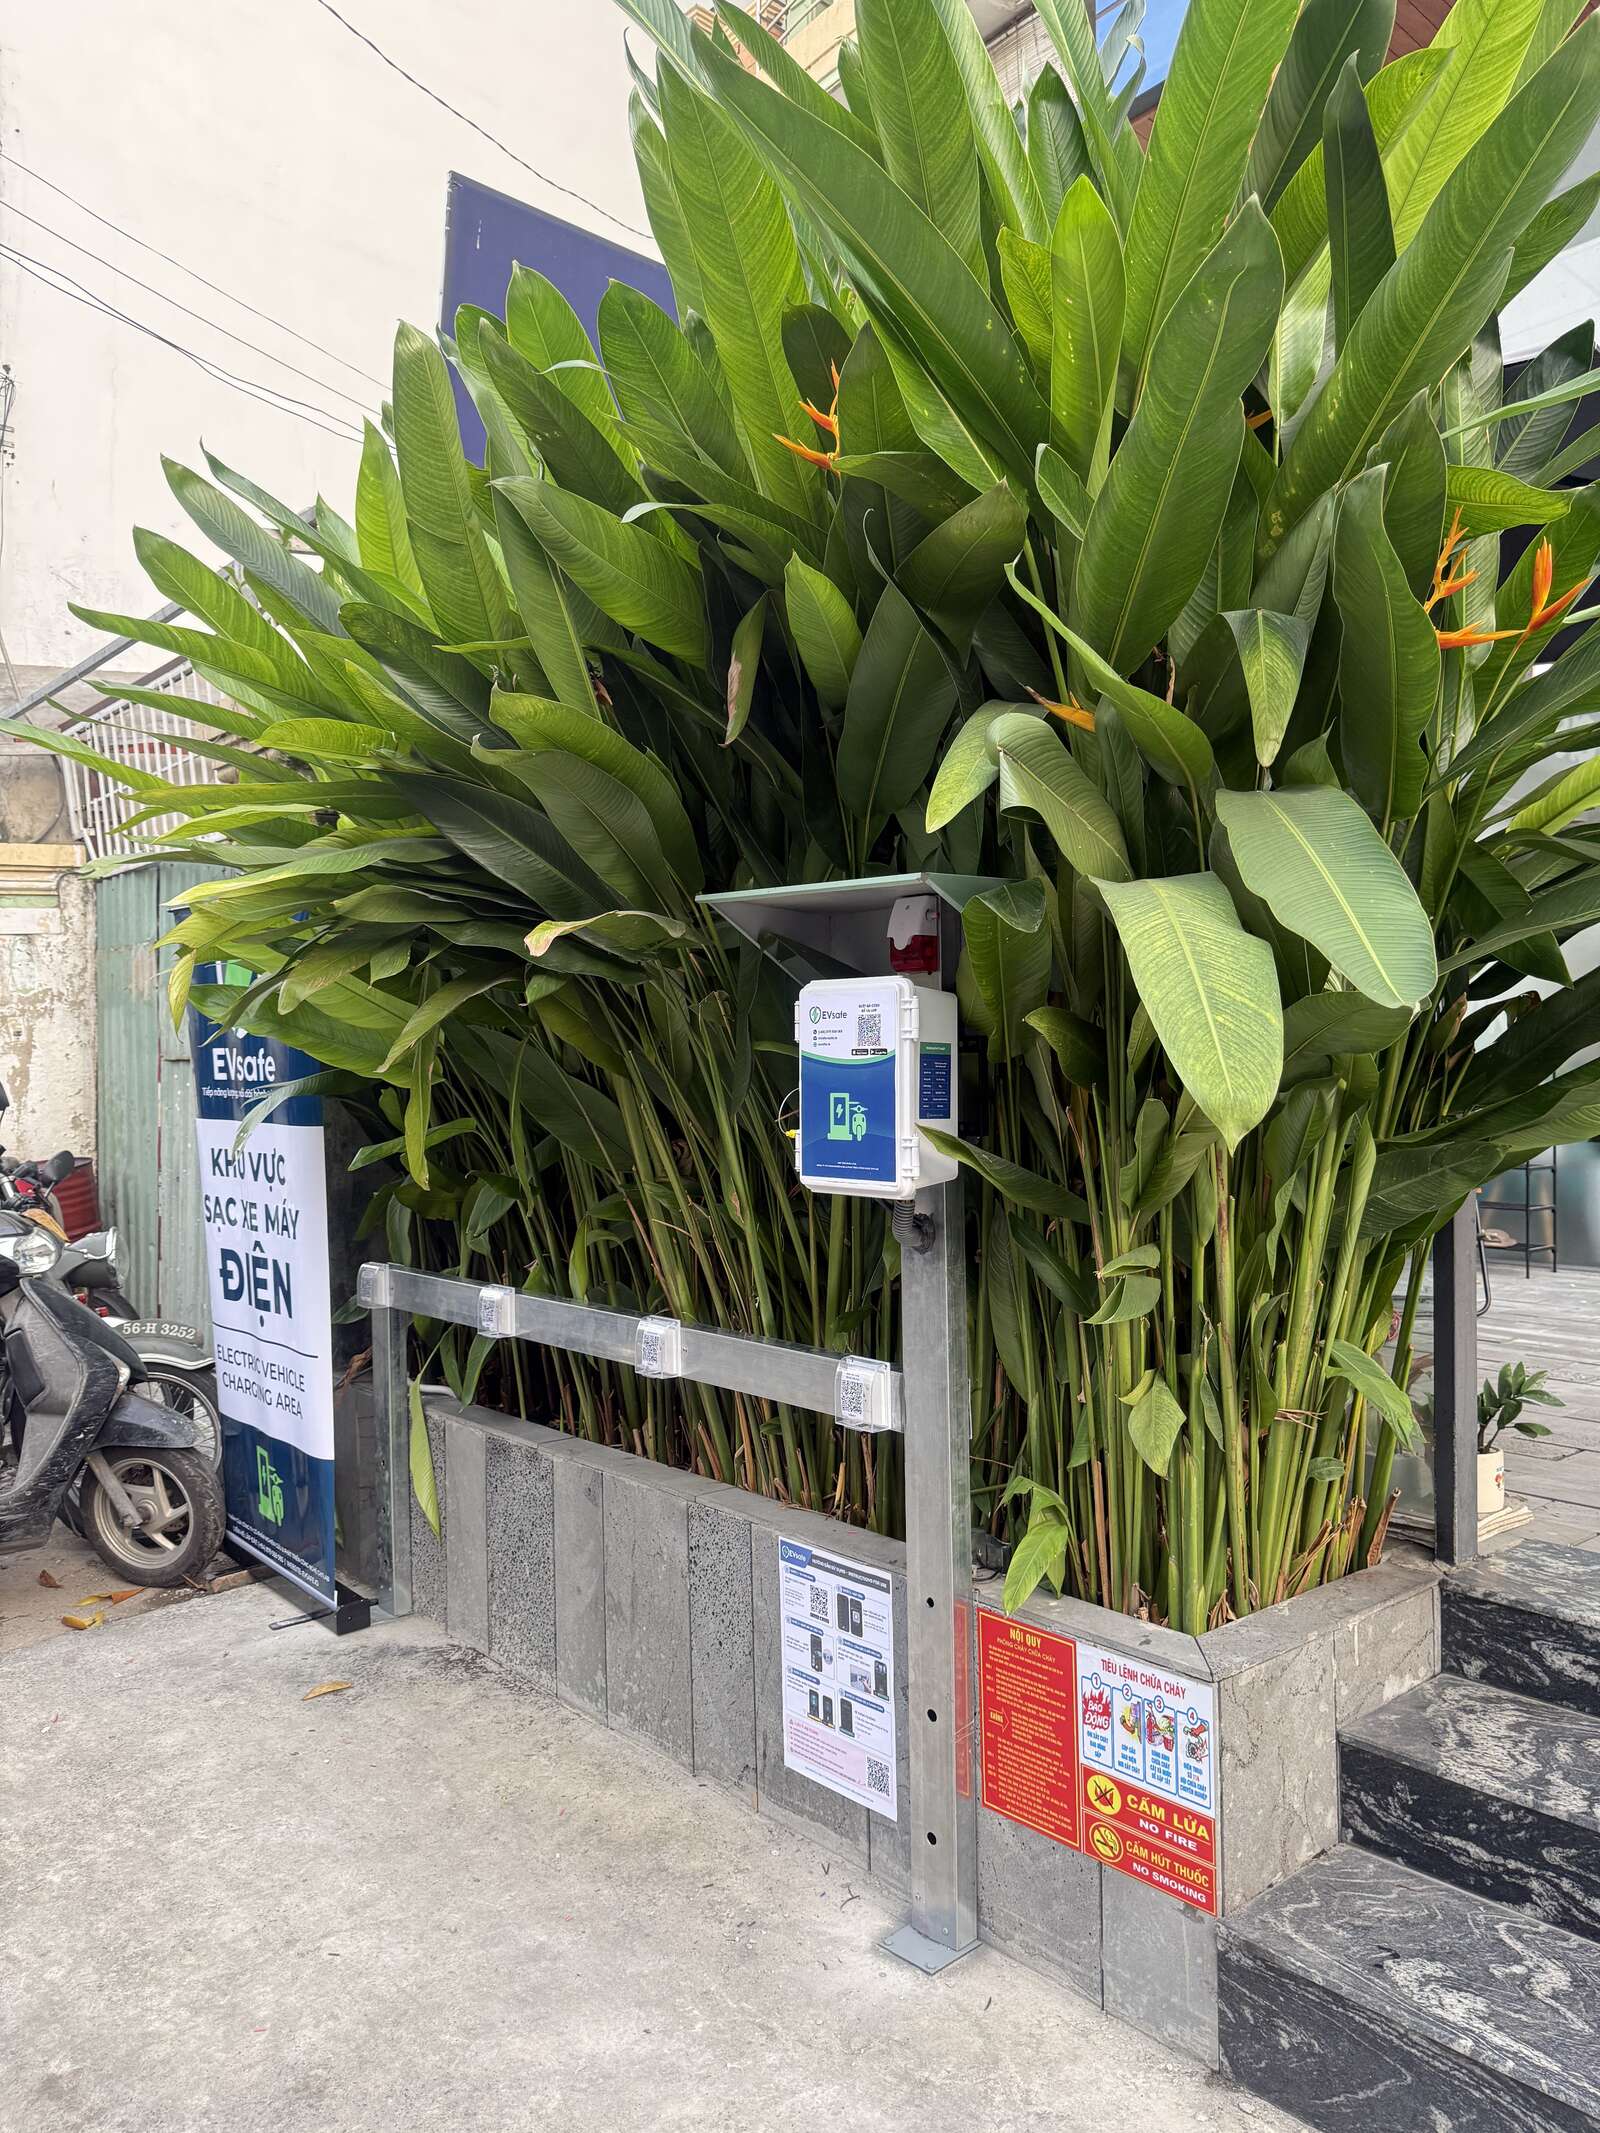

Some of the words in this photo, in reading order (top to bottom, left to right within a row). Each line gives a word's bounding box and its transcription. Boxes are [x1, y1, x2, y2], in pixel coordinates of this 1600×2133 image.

[822, 1010, 848, 1020] EVsafe
[212, 1047, 276, 1082] EVsafe
[211, 1147, 246, 1180] KHU
[248, 1147, 286, 1192] VỰC
[204, 1194, 238, 1233] SẠC
[241, 1199, 259, 1232] XE
[264, 1198, 300, 1240] MÁY
[219, 1240, 293, 1327] ĐIỆN
[121, 1322, 157, 1335] 56-H
[160, 1323, 197, 1340] 3252
[216, 1343, 261, 1375] ELECTRIC
[261, 1356, 305, 1392] VEHICLE
[222, 1372, 272, 1406] CHARGING
[276, 1392, 304, 1420] AREA
[789, 1549, 807, 1562] EVsafe
[1009, 1627, 1024, 1643] NỘI
[1026, 1633, 1042, 1648] QUY
[1093, 1676, 1099, 1686] 1
[1101, 1658, 1117, 1675] TIÊU
[1118, 1663, 1139, 1682] LỆNH
[1139, 1673, 1162, 1691] CHỮA
[1163, 1681, 1187, 1699] CHÁY
[1124, 1688, 1130, 1697] 2
[1156, 1700, 1162, 1708] 3
[1188, 1712, 1195, 1721] 4
[1126, 1793, 1166, 1821] CẤM
[1173, 1813, 1210, 1841] LỬA
[1139, 1818, 1160, 1834] NO
[1165, 1830, 1198, 1851] FIRE
[1126, 1840, 1149, 1859] CẤM
[1151, 1852, 1170, 1871] HÚT
[1174, 1861, 1209, 1887] THUỐC
[1133, 1862, 1150, 1876] NO
[1152, 1870, 1207, 1904] SMOKING
